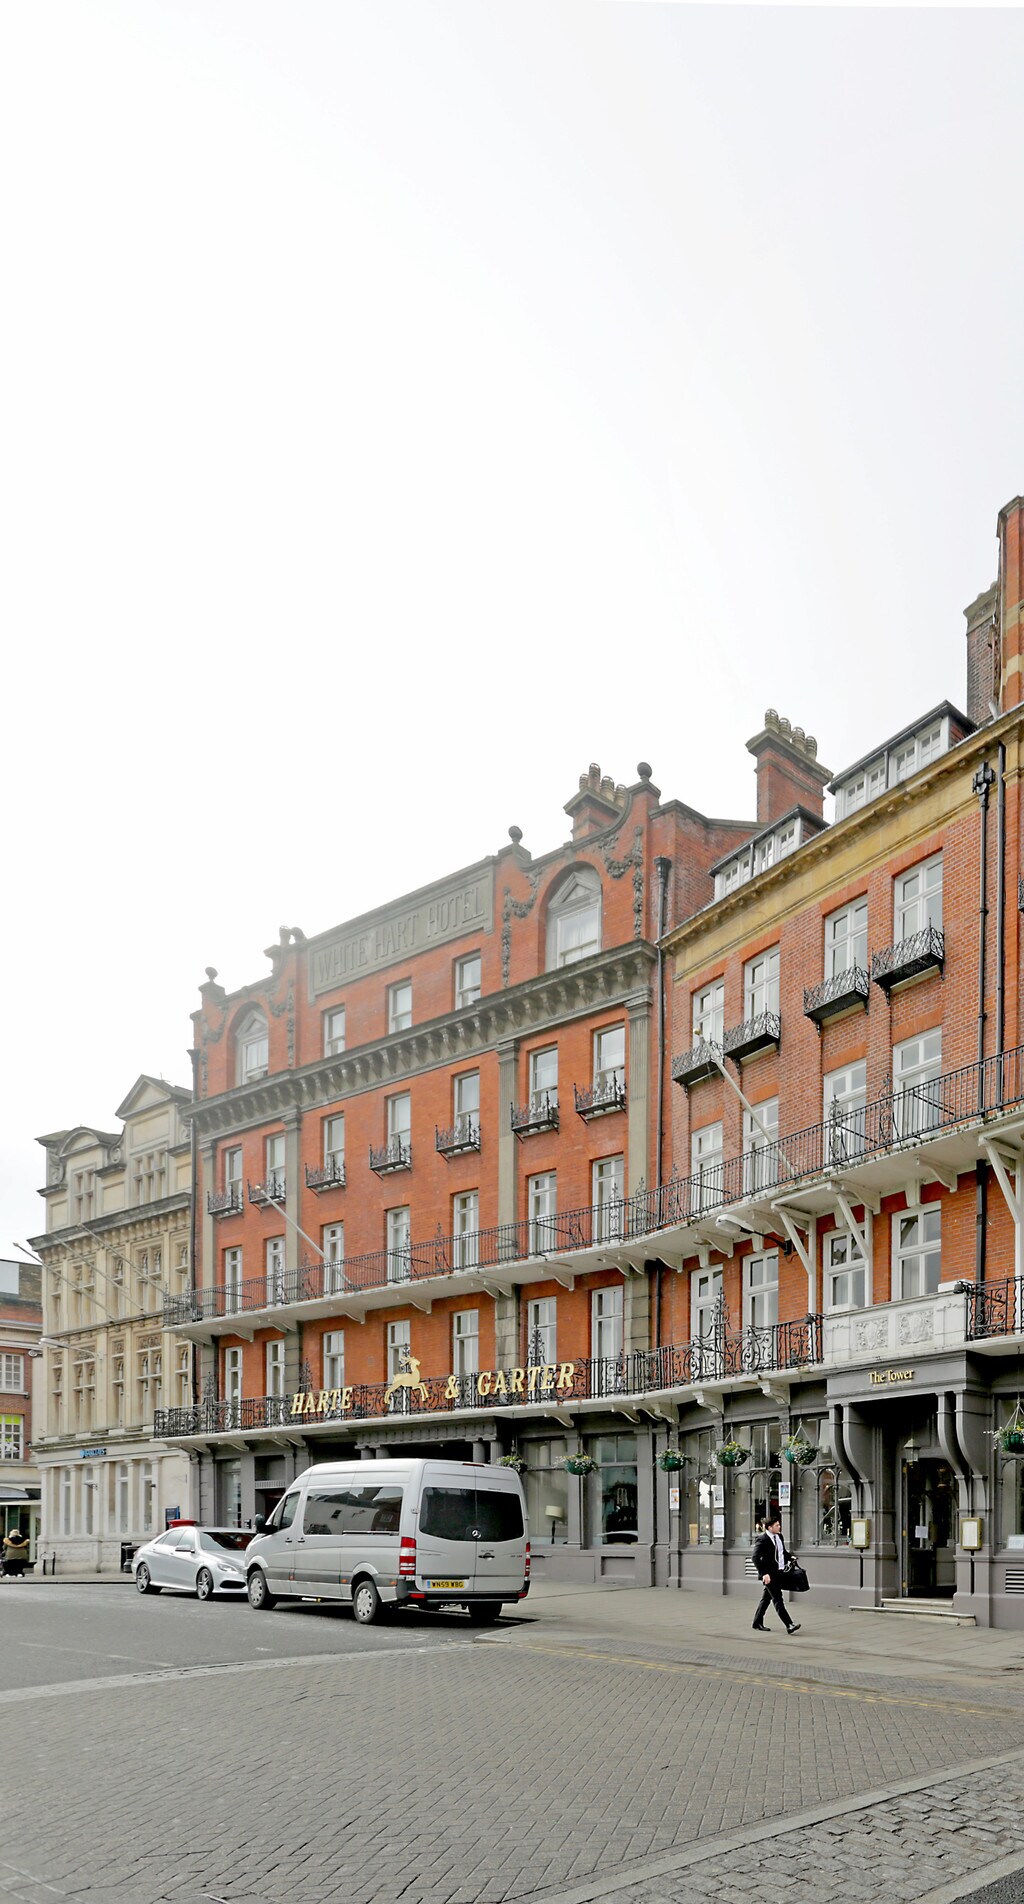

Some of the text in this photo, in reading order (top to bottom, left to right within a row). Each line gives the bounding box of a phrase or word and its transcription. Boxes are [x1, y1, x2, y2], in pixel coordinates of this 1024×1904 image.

[318, 887, 485, 983] WHITE HART HOTEL
[290, 1362, 575, 1415] HARTE & GARTER
[868, 1369, 914, 1383] The Tower
